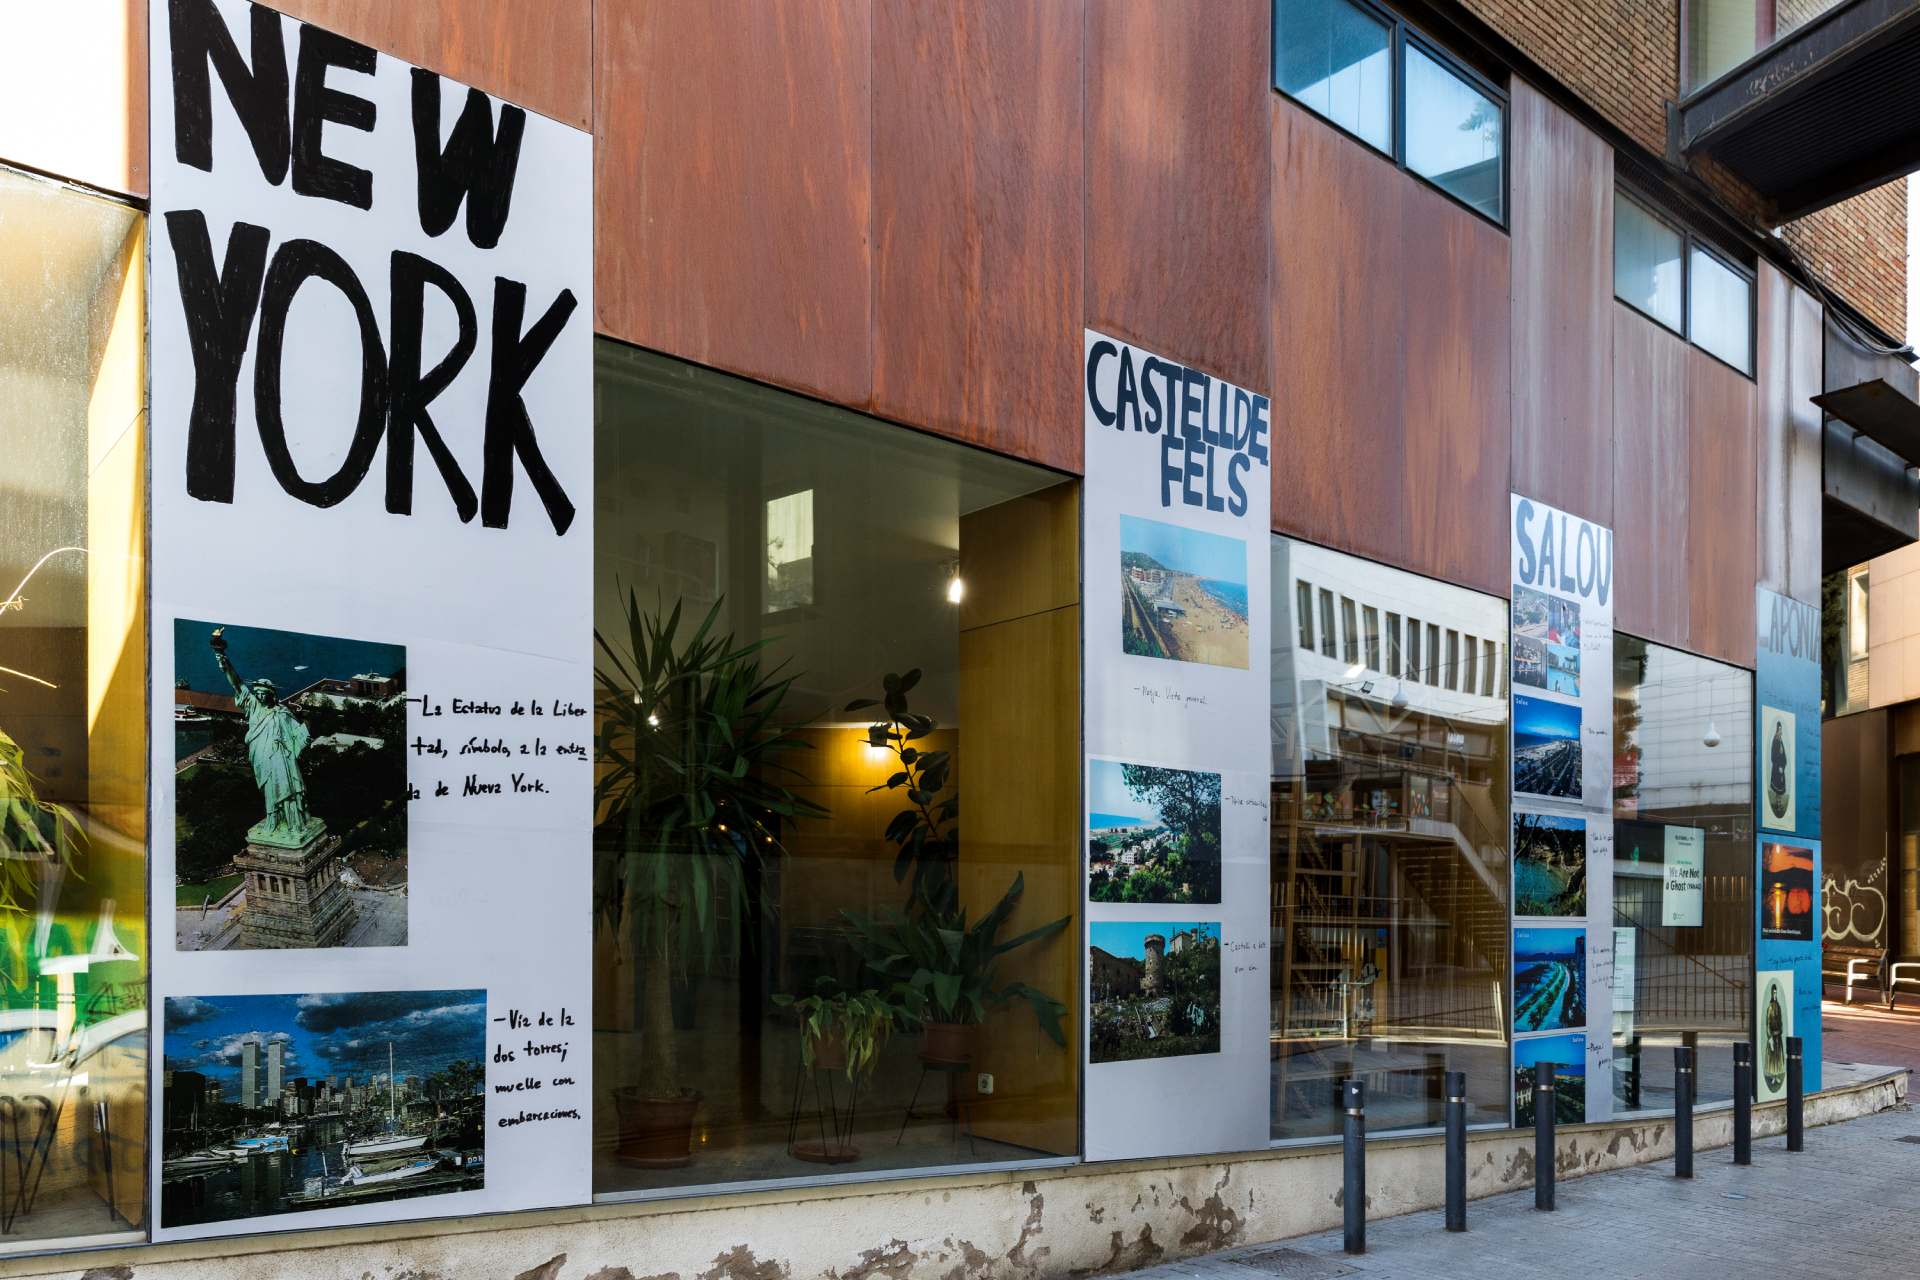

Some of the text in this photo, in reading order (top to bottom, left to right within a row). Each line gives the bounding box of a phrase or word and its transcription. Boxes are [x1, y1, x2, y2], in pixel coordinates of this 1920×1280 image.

[168, 0, 526, 248] NEW
[165, 209, 578, 536] YORK
[1160, 432, 1251, 517] FELS
[1516, 499, 1612, 607] SALOU
[510, 701, 525, 716] de
[531, 699, 544, 716] la
[535, 737, 547, 756] la
[435, 780, 449, 797] de
[463, 774, 502, 797] Nueva
[511, 772, 550, 794] York.
[1679, 867, 1688, 878] Are
[1689, 867, 1700, 879] Not
[1670, 880, 1686, 892] Ghost
[538, 1011, 554, 1027] de
[560, 1007, 575, 1027] la
[493, 1043, 516, 1063] dos
[495, 1076, 575, 1094] muelle con
